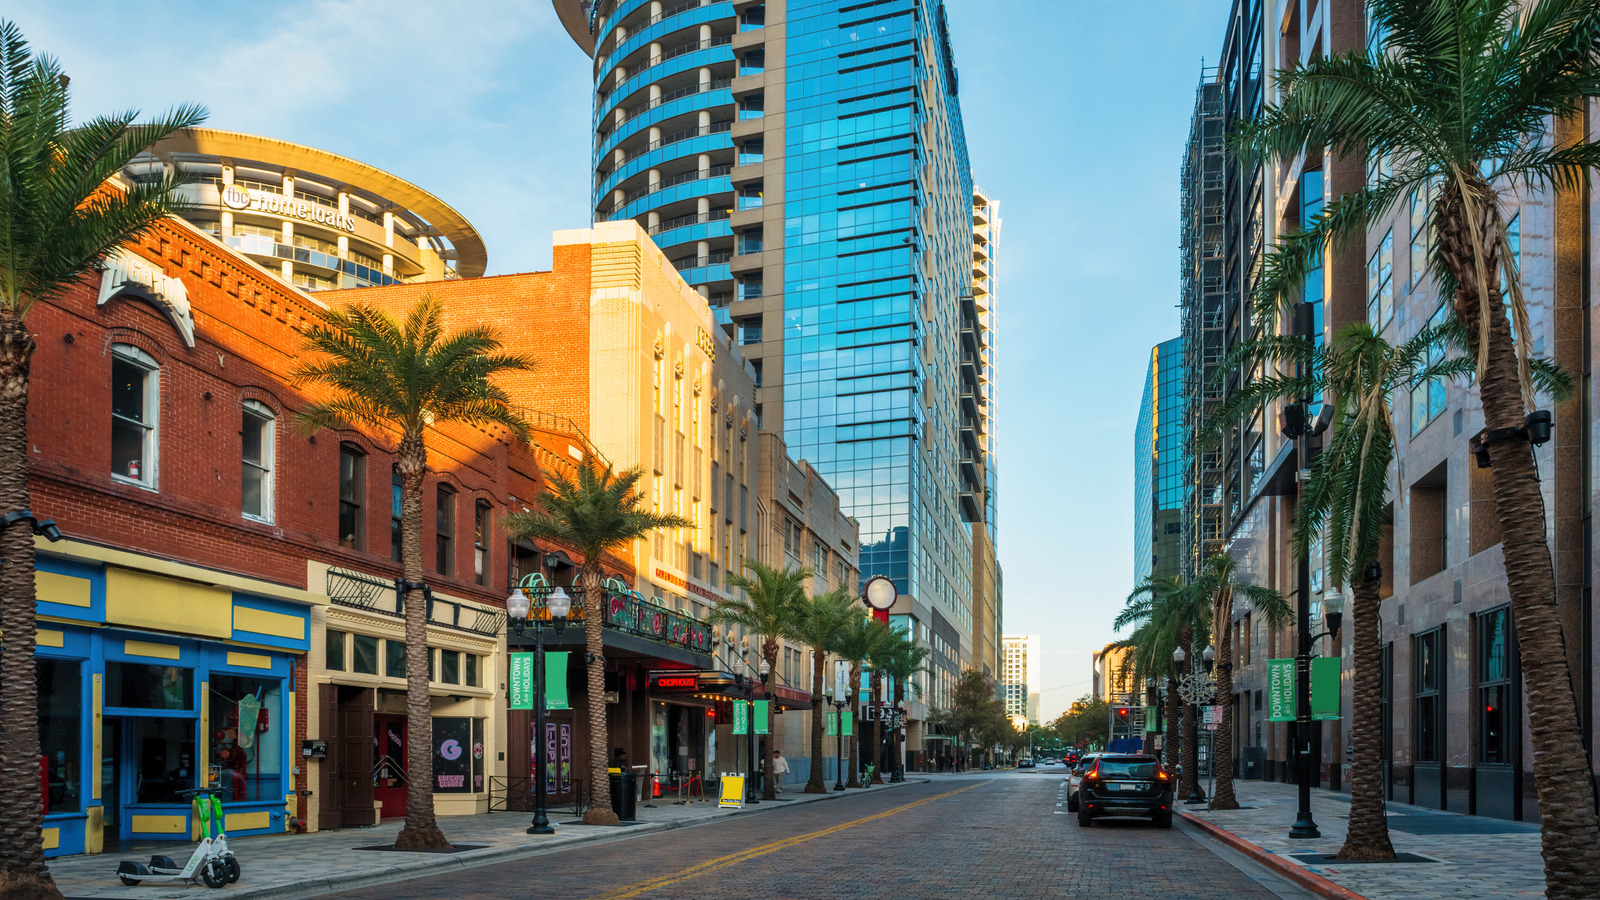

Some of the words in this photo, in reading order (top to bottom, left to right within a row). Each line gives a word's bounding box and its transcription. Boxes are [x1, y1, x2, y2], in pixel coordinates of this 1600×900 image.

[227, 186, 248, 204] fbc
[260, 195, 307, 218] home
[311, 200, 355, 232] loans
[512, 657, 520, 705] DOWNTOWN
[658, 678, 695, 687] CHOPHOUSE
[1271, 664, 1281, 717] DOWNTOWN
[1283, 664, 1292, 702] HOLIDAYS
[441, 739, 462, 760] G
[186, 855, 200, 872] Lime
